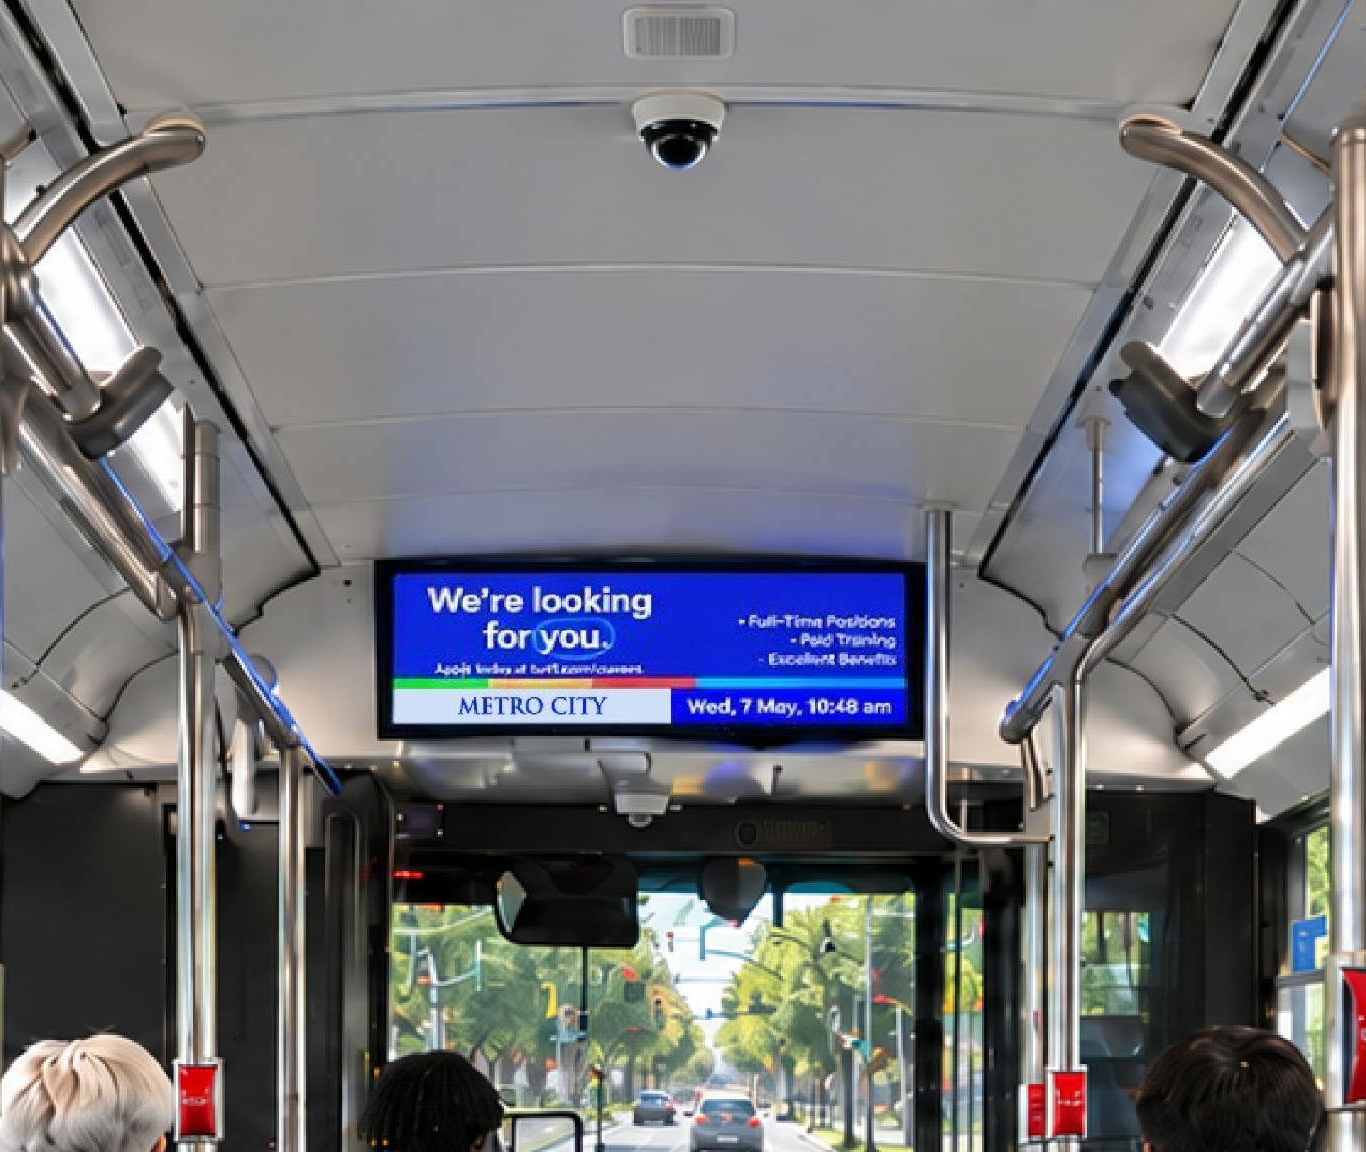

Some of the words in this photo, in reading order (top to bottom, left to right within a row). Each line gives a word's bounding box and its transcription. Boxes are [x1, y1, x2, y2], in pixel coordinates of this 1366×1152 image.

[427, 587, 524, 613] We're
[532, 585, 652, 619] looking
[483, 619, 531, 649] for
[539, 628, 611, 654] you.
[458, 696, 543, 715] METRO
[552, 696, 607, 715] CITY
[688, 698, 736, 716] Wed,
[741, 699, 751, 714] 7
[757, 699, 802, 718] May,
[808, 699, 858, 714] 10:48
[863, 702, 892, 714] am
